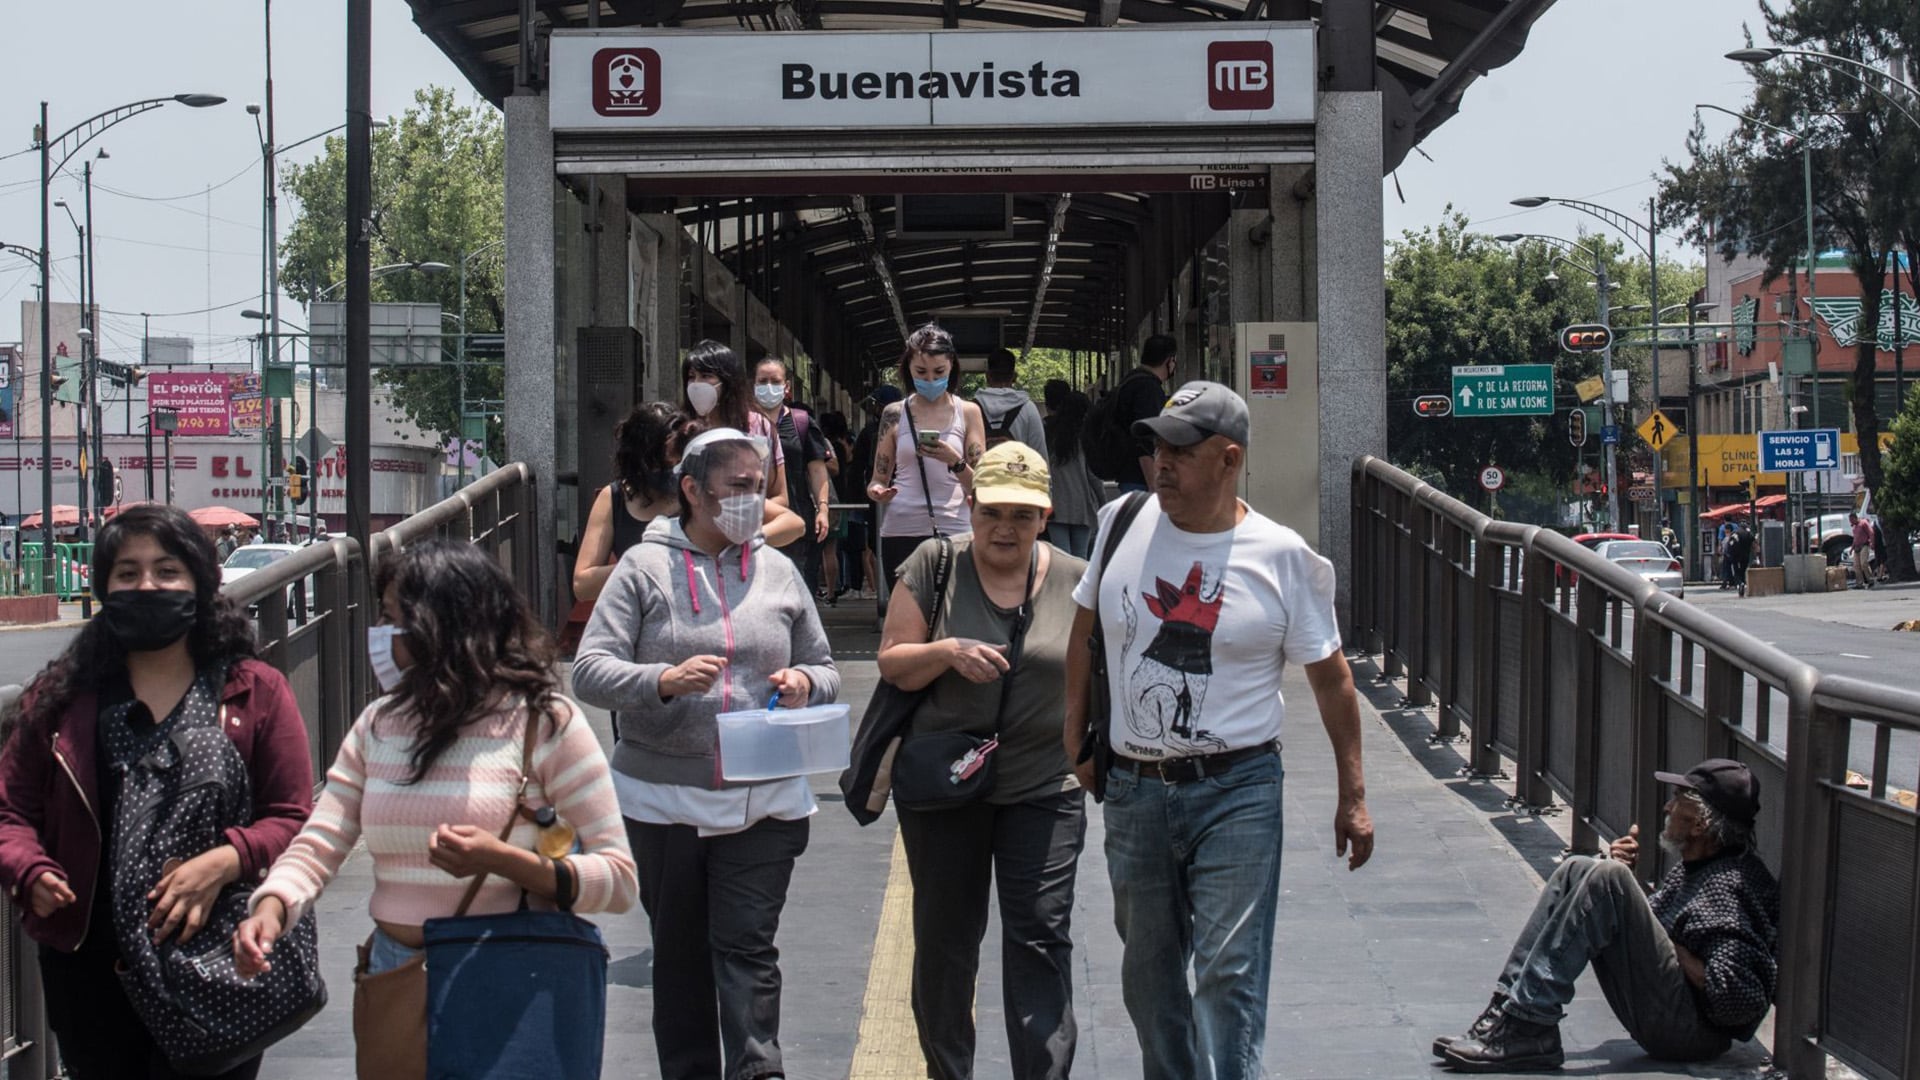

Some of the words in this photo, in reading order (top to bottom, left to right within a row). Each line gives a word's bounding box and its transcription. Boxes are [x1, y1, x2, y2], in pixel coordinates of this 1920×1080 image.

[782, 61, 1081, 99] Buenavista
[153, 384, 169, 394] EL
[1486, 381, 1496, 392] DE
[1499, 381, 1510, 392] LA
[1512, 380, 1548, 392] REFORMA
[1477, 399, 1484, 409] R
[1486, 398, 1498, 409] DE
[1501, 397, 1517, 408] SAN
[1520, 397, 1547, 408] COSME
[208, 418, 220, 427] 73
[1769, 436, 1810, 444] SERVICIO
[1775, 448, 1791, 456] LAS
[1794, 448, 1804, 456] 24
[211, 456, 253, 478] EL
[1775, 459, 1806, 468] HORAS
[1486, 471, 1498, 480] 50
